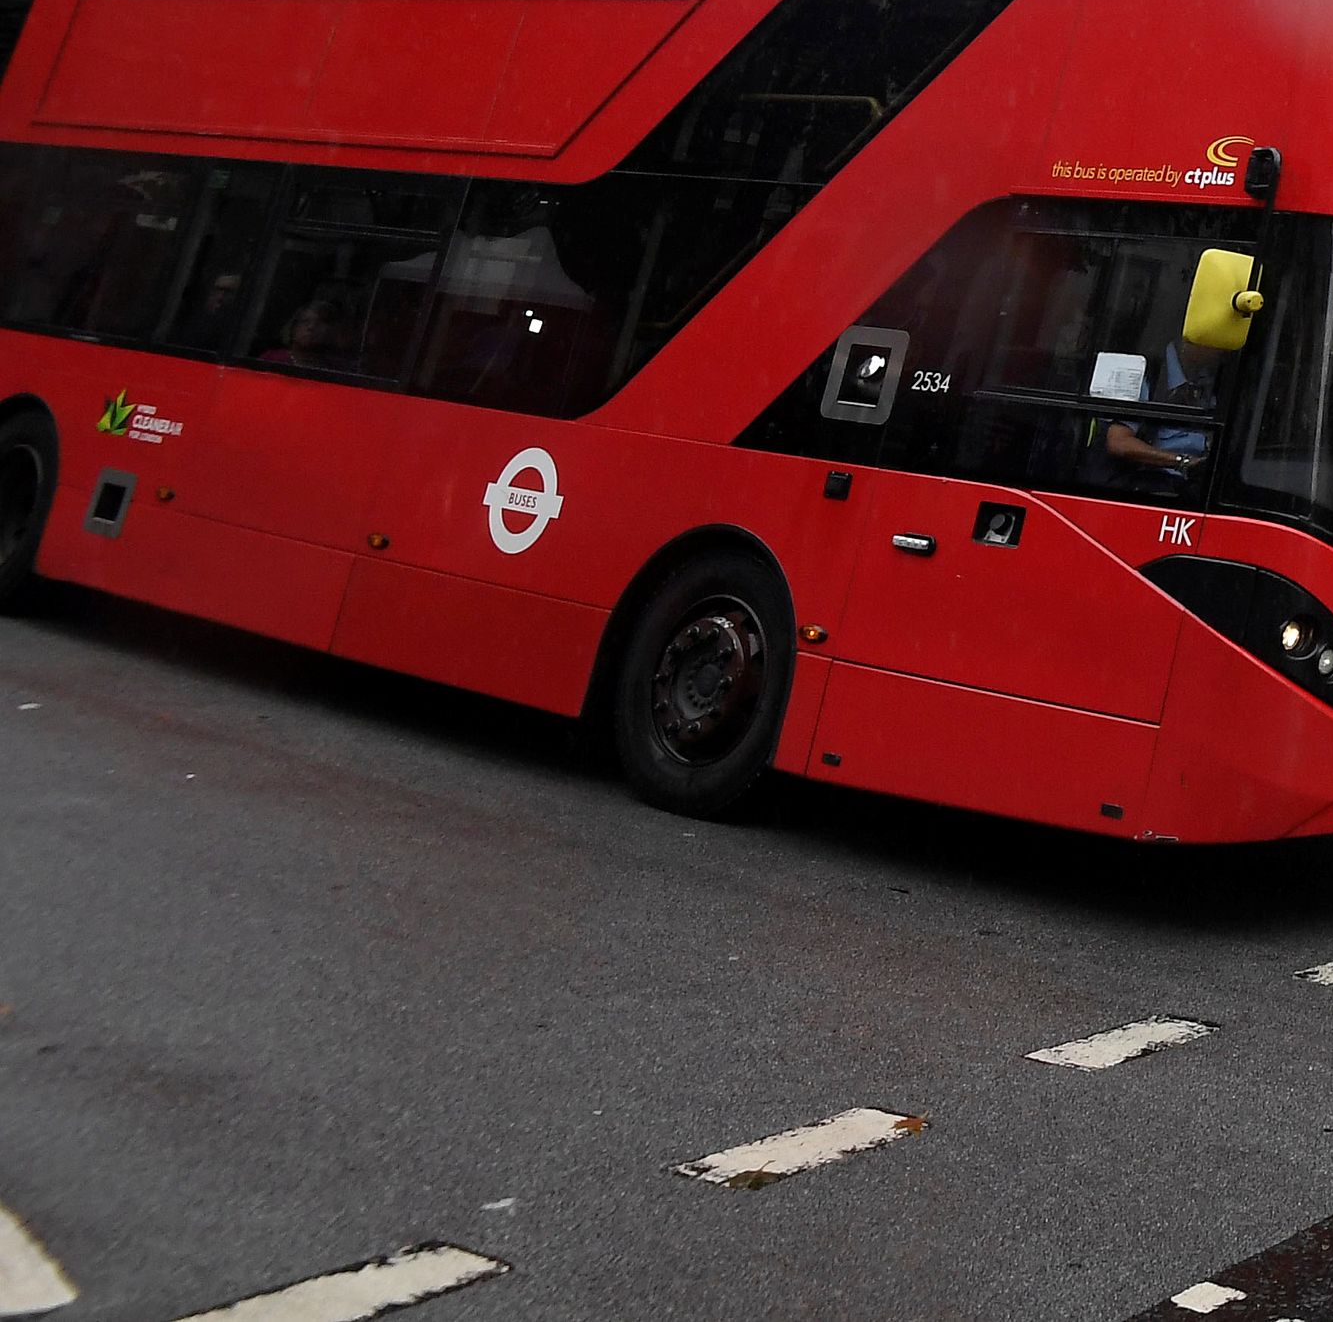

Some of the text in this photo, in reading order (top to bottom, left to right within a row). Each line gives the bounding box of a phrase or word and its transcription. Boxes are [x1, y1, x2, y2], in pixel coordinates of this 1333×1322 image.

[1052, 161, 1072, 178] this
[1073, 161, 1095, 180] bus
[1097, 163, 1106, 180] is
[1108, 165, 1166, 184] operated
[1165, 165, 1182, 188] by
[911, 370, 951, 393] 2534
[508, 492, 537, 508] BUSES
[1158, 515, 1196, 547] HK
